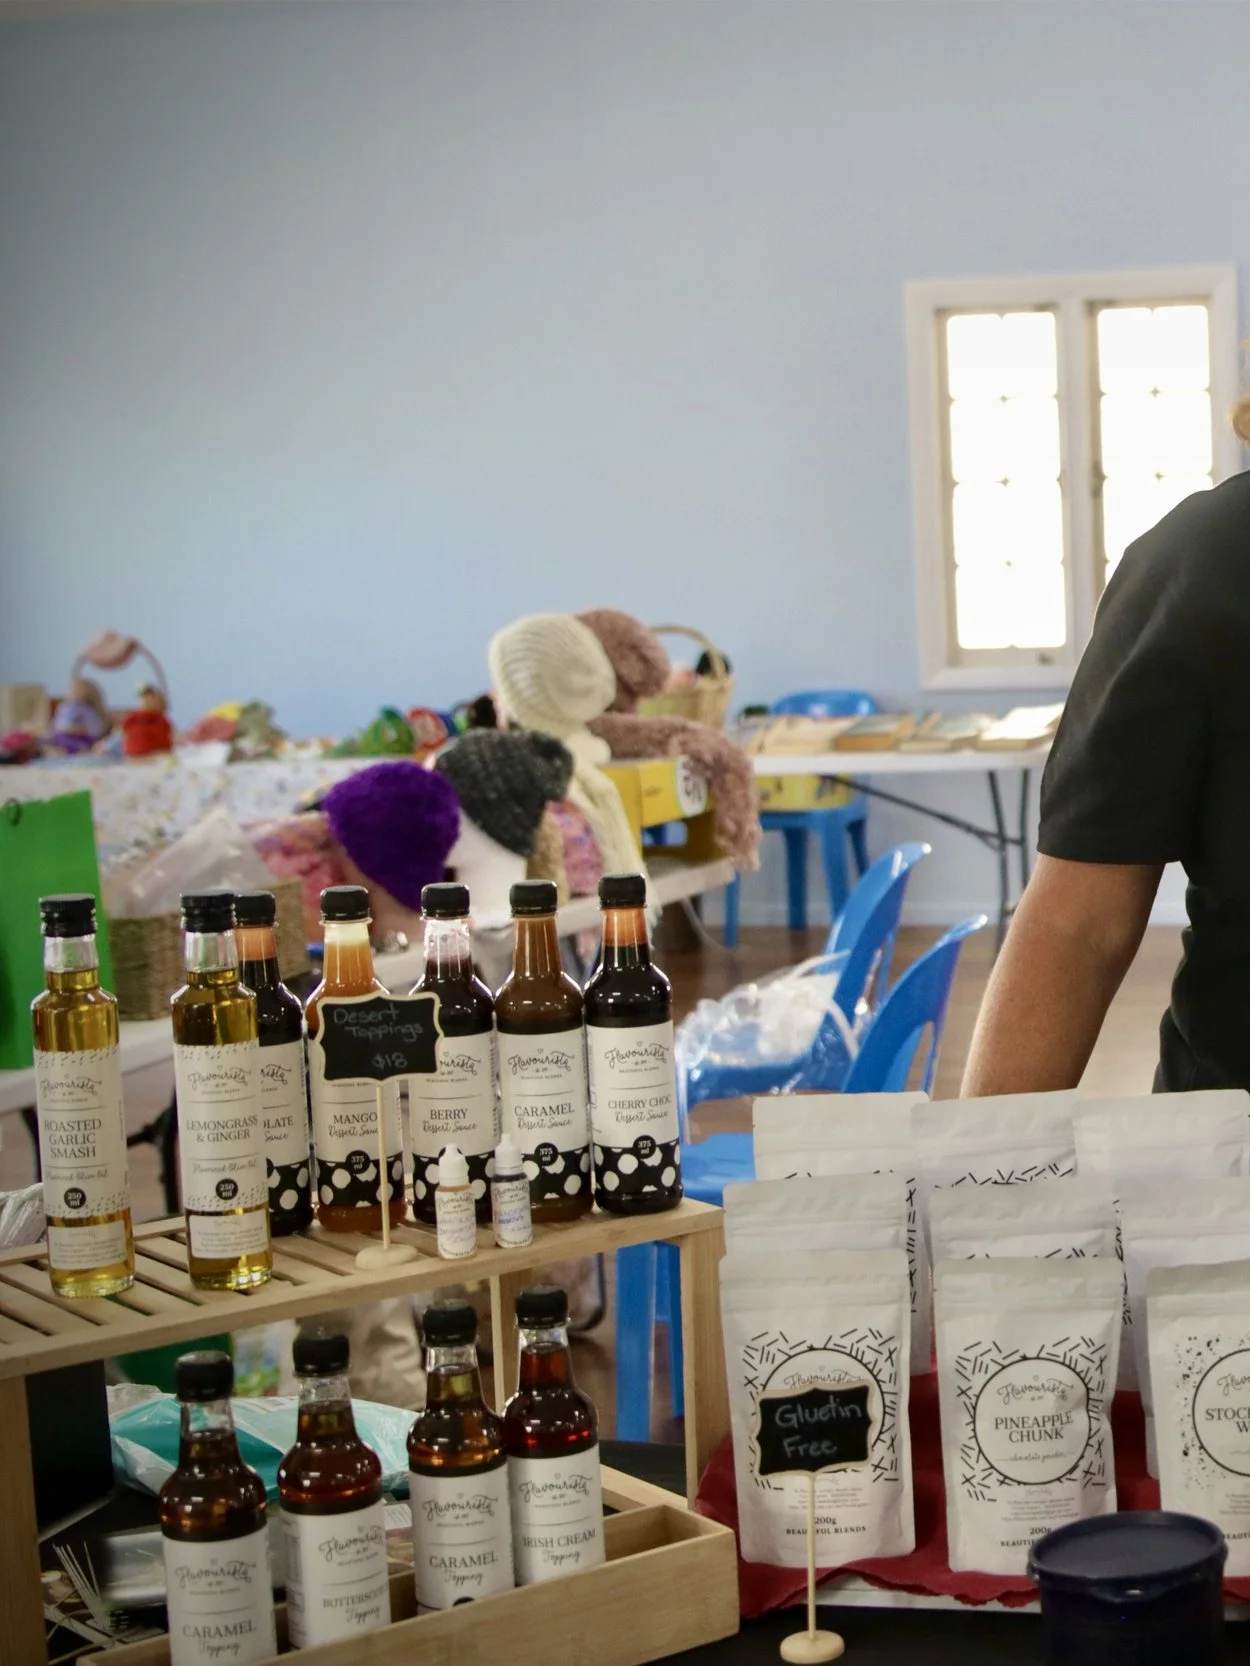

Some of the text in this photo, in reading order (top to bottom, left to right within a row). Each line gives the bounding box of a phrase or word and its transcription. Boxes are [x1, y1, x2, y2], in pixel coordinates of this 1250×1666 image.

[333, 1003, 399, 1025] Desert
[344, 1023, 424, 1043] Toppings
[372, 1052, 408, 1069] $18
[508, 1050, 575, 1075] Flavourista
[514, 1103, 575, 1117] CARAMEL
[608, 1099, 647, 1110] CHERRY
[333, 1112, 378, 1124] MANGO
[430, 1108, 468, 1120] BERRY
[615, 1109, 669, 1125] Dessert Sauce
[44, 1118, 102, 1132] ROASTED
[186, 1115, 258, 1132] LEMONGRASS
[422, 1121, 478, 1135] Dessert Sauce
[517, 1117, 573, 1130] Dessert Sauce
[49, 1132, 97, 1146] GARLIC
[196, 1130, 251, 1143] & GINGER
[637, 1140, 652, 1148] 375
[50, 1146, 97, 1159] SMASH
[351, 1155, 365, 1163] 375
[539, 1148, 553, 1156] 375
[219, 1184, 234, 1192] 250
[222, 1190, 233, 1198] ml
[67, 1191, 82, 1200] 250
[70, 1199, 81, 1207] ml
[997, 1378, 1074, 1406] Flavourista
[994, 1411, 1074, 1430] PINEAPPLE
[1008, 1427, 1065, 1444] CHUNK
[782, 1436, 838, 1459] Free
[786, 1525, 867, 1536] BEAUFUL BLENDS
[523, 1528, 597, 1549] IRISH CREAM
[429, 1551, 499, 1569] CARAMEL
[182, 1619, 255, 1639] CARAMEL
